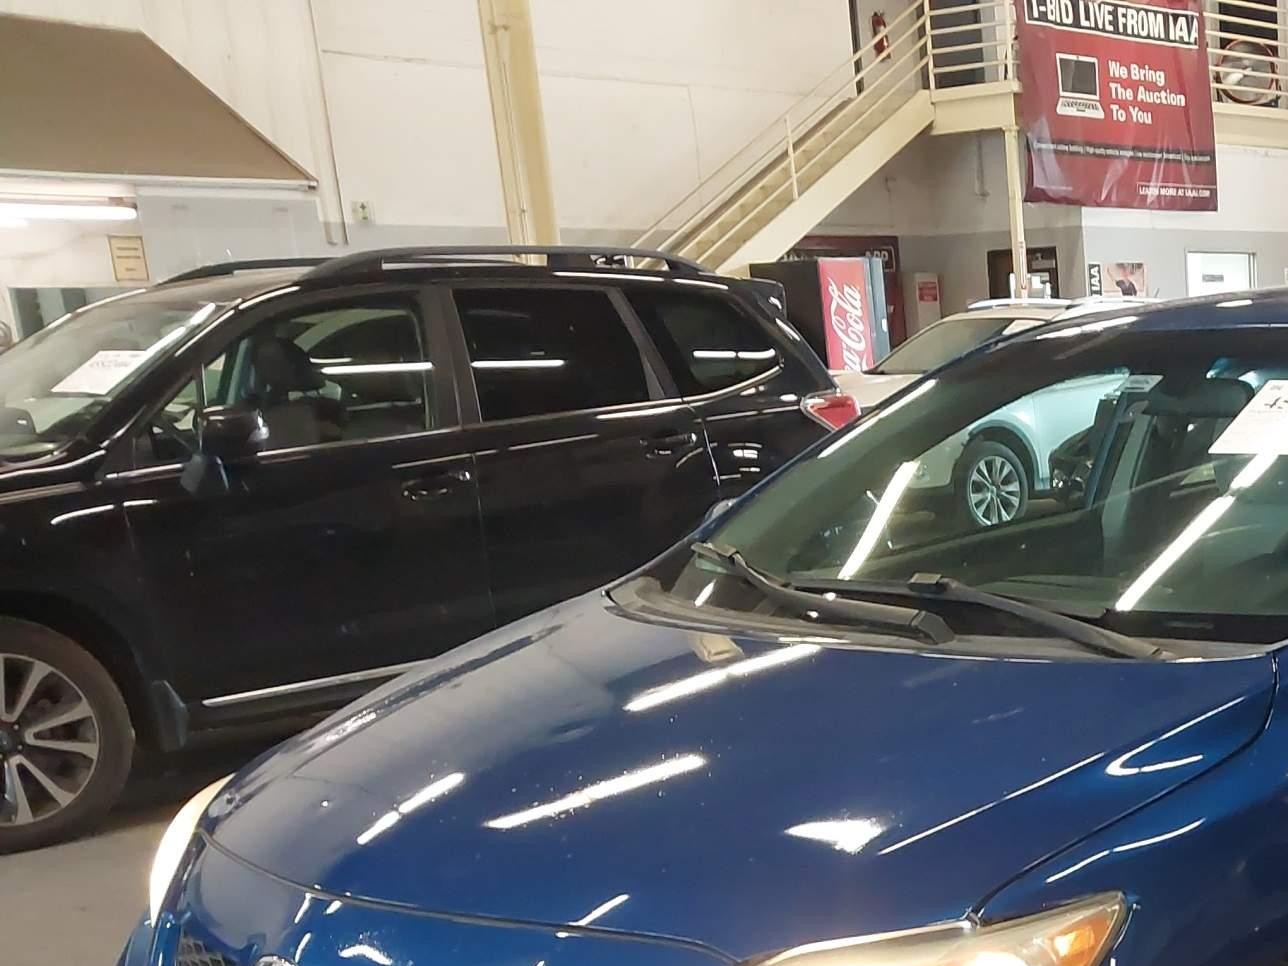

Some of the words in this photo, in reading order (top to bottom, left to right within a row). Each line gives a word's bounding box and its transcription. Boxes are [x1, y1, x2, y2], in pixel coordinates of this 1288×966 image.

[1079, 0, 1114, 32] LIVE
[1117, 6, 1165, 39] FROM
[1108, 59, 1128, 79] We
[1130, 63, 1166, 87] Bring
[1109, 82, 1134, 101] The
[1137, 85, 1186, 107] Auction
[1110, 104, 1127, 122] To
[1128, 105, 1152, 125] You
[1160, 187, 1177, 196] MORE
[1090, 266, 1101, 291] IAA
